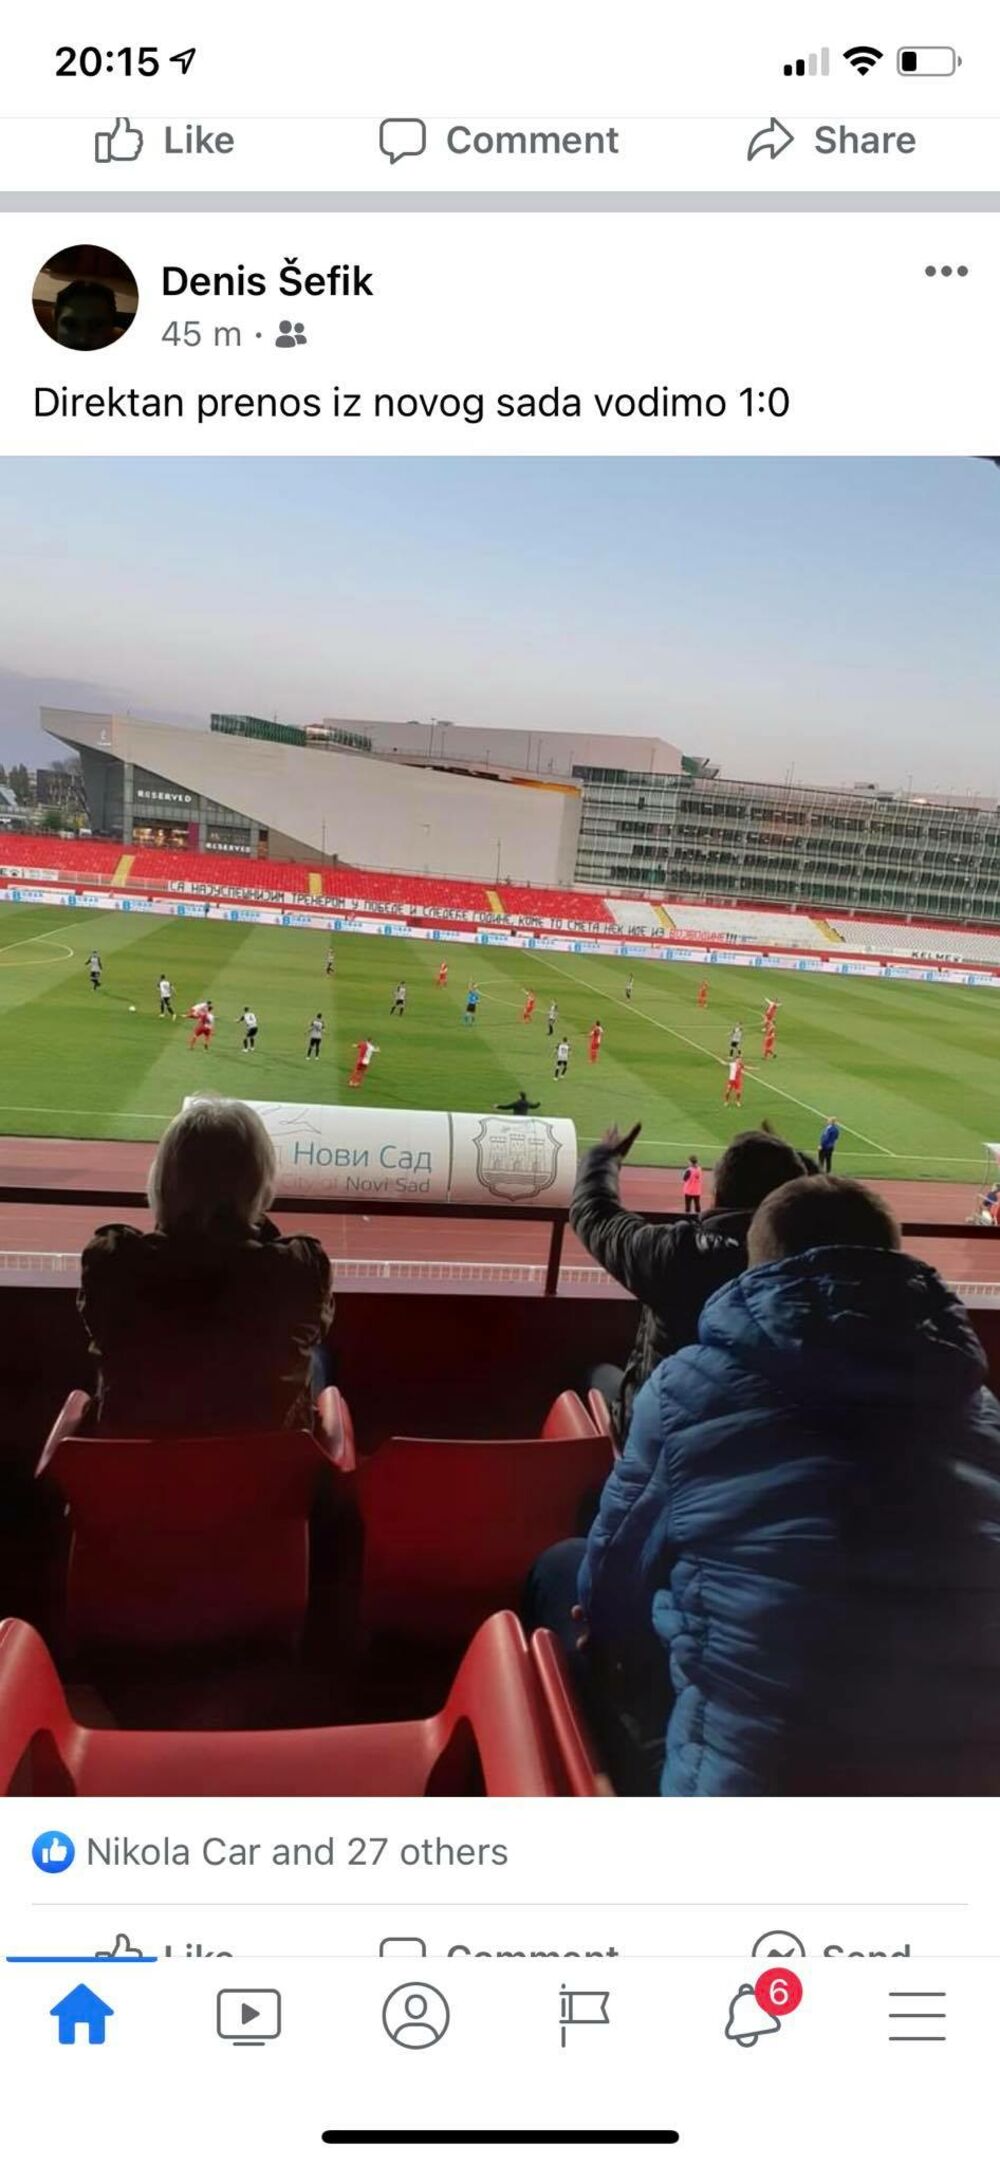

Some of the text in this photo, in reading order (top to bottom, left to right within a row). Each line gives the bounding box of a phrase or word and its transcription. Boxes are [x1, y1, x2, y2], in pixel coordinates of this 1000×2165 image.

[137, 789, 192, 803] RESERVED
[205, 842, 251, 853] RESERVED
[294, 1141, 369, 1167] Нови
[379, 1145, 432, 1173] Сад
[346, 1176, 388, 1192] Novi
[395, 1177, 430, 1193] Sad
